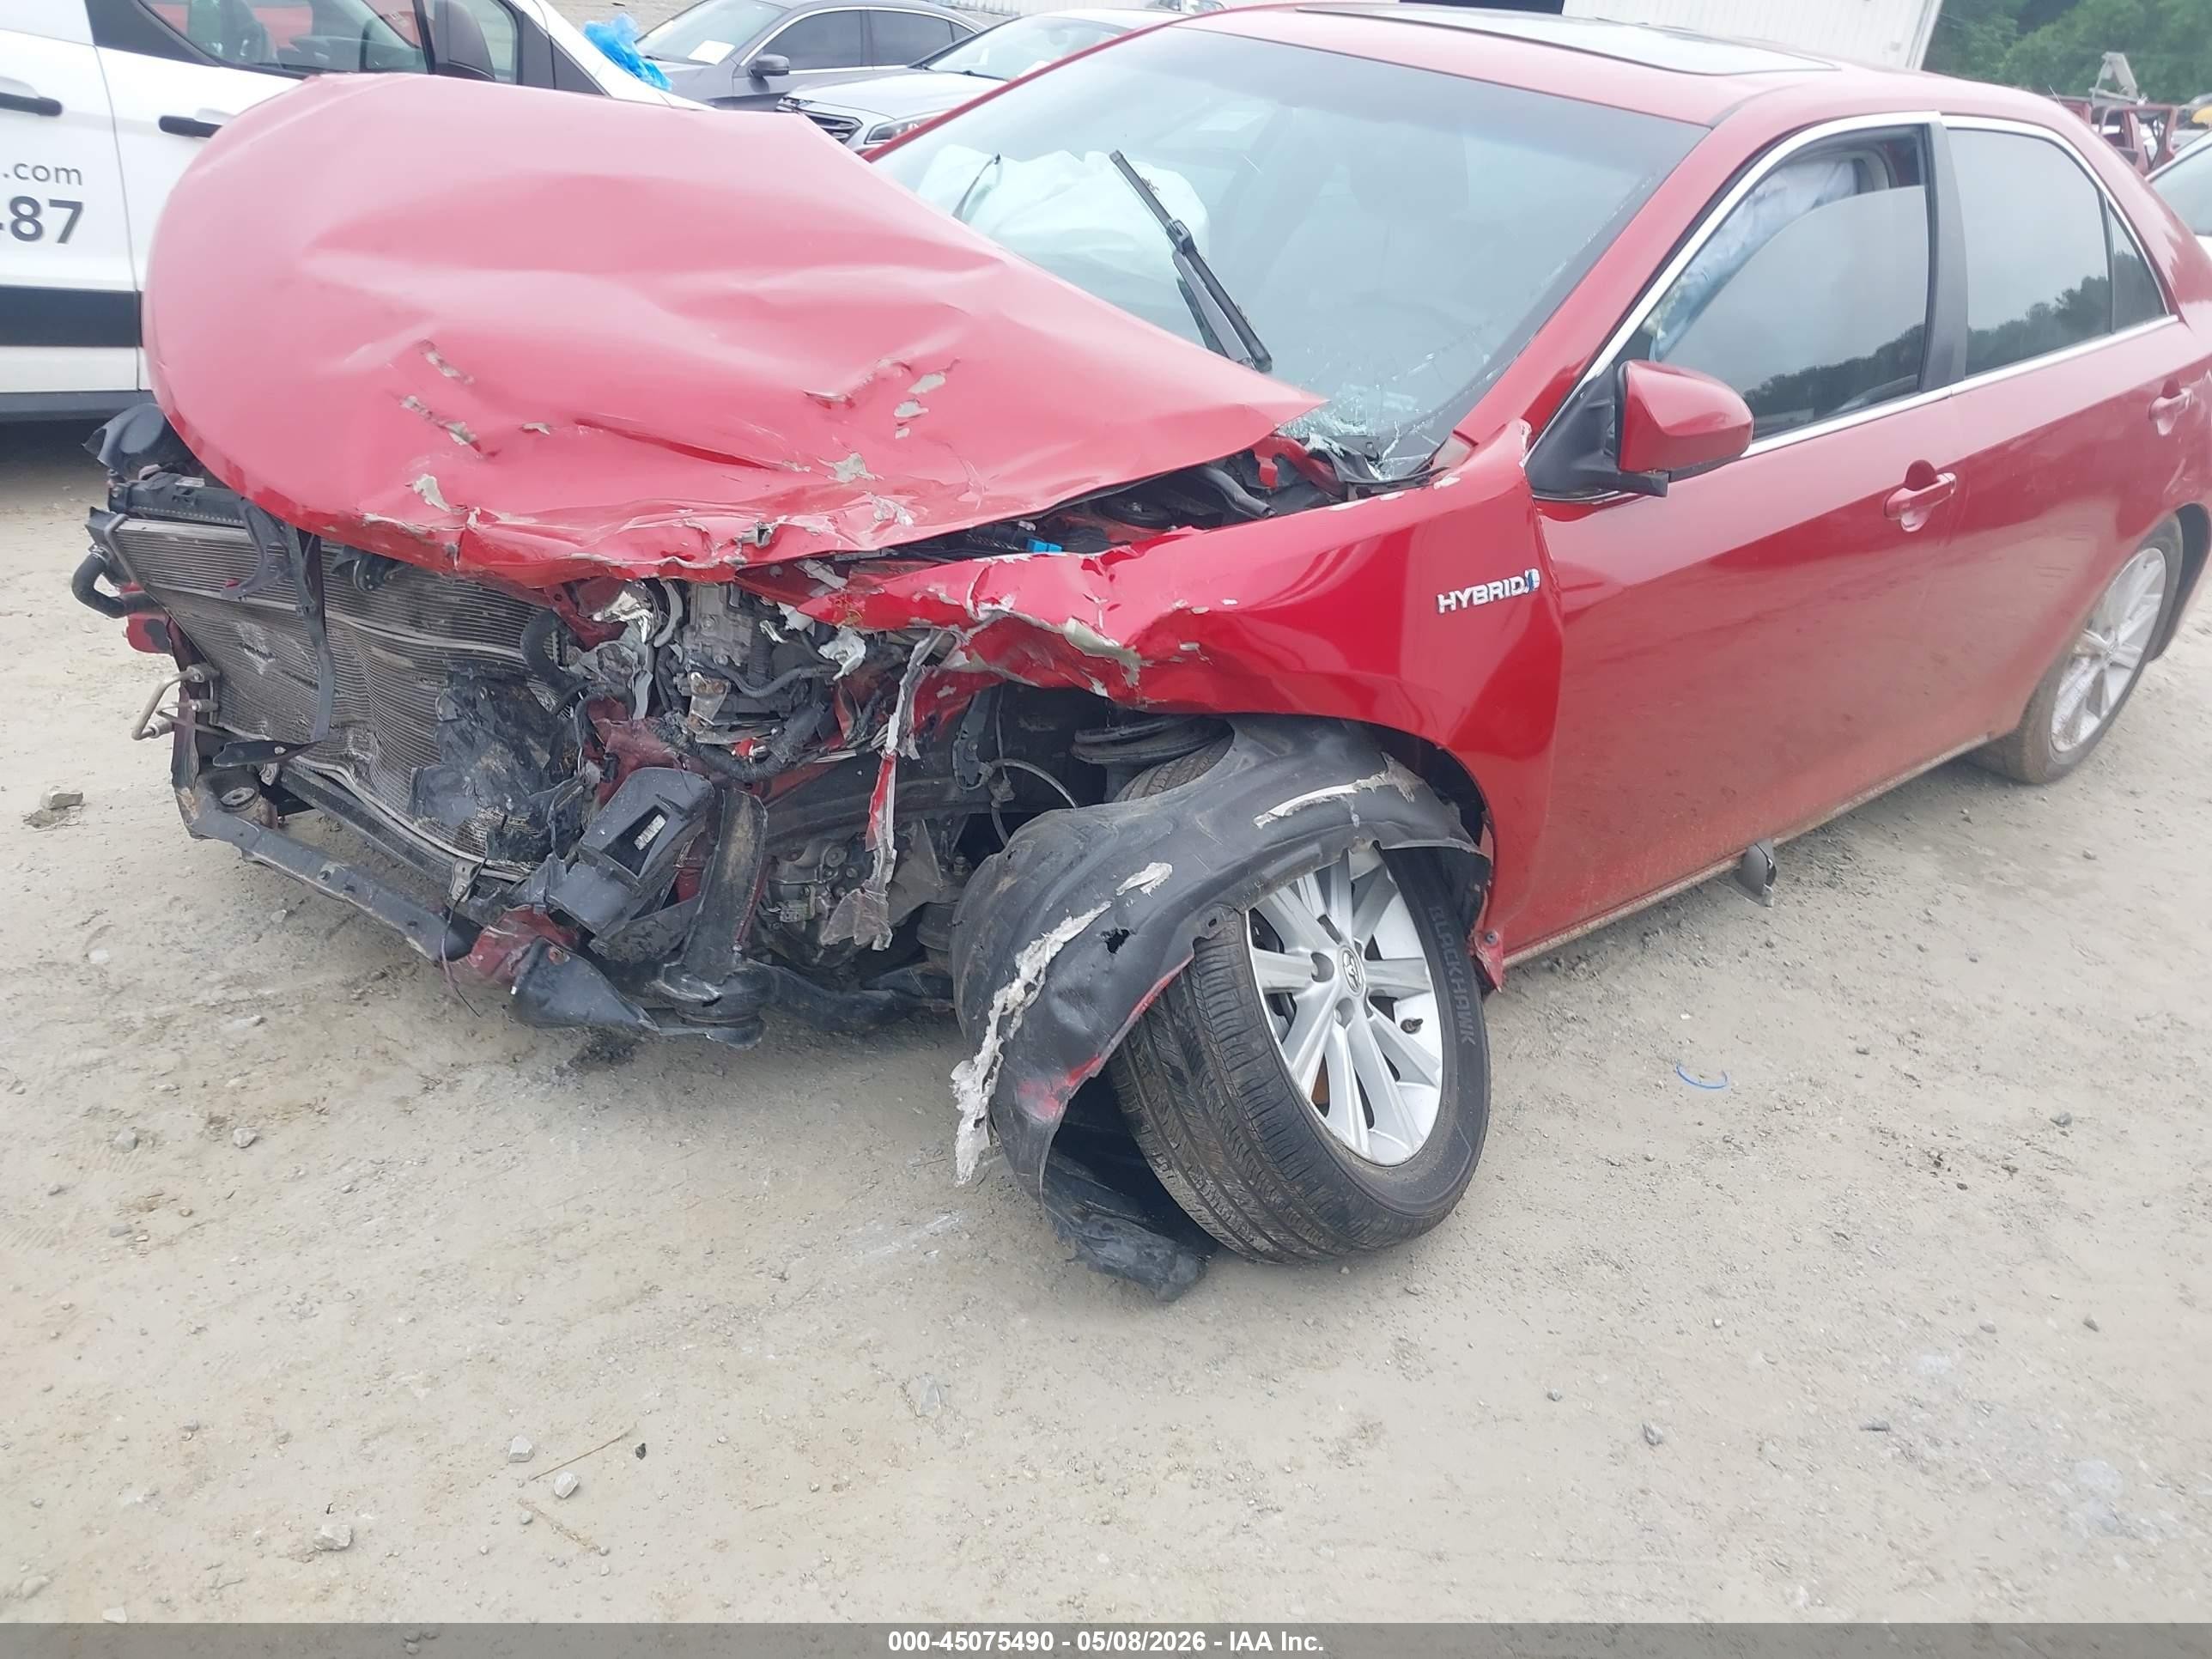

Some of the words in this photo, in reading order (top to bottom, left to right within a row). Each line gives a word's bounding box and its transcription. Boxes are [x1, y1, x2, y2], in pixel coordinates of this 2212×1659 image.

[3, 162, 83, 186] .com
[0, 195, 84, 244] 87
[1437, 575, 1526, 614] HYBRID
[1428, 906, 1476, 1046] BLACKHAWK
